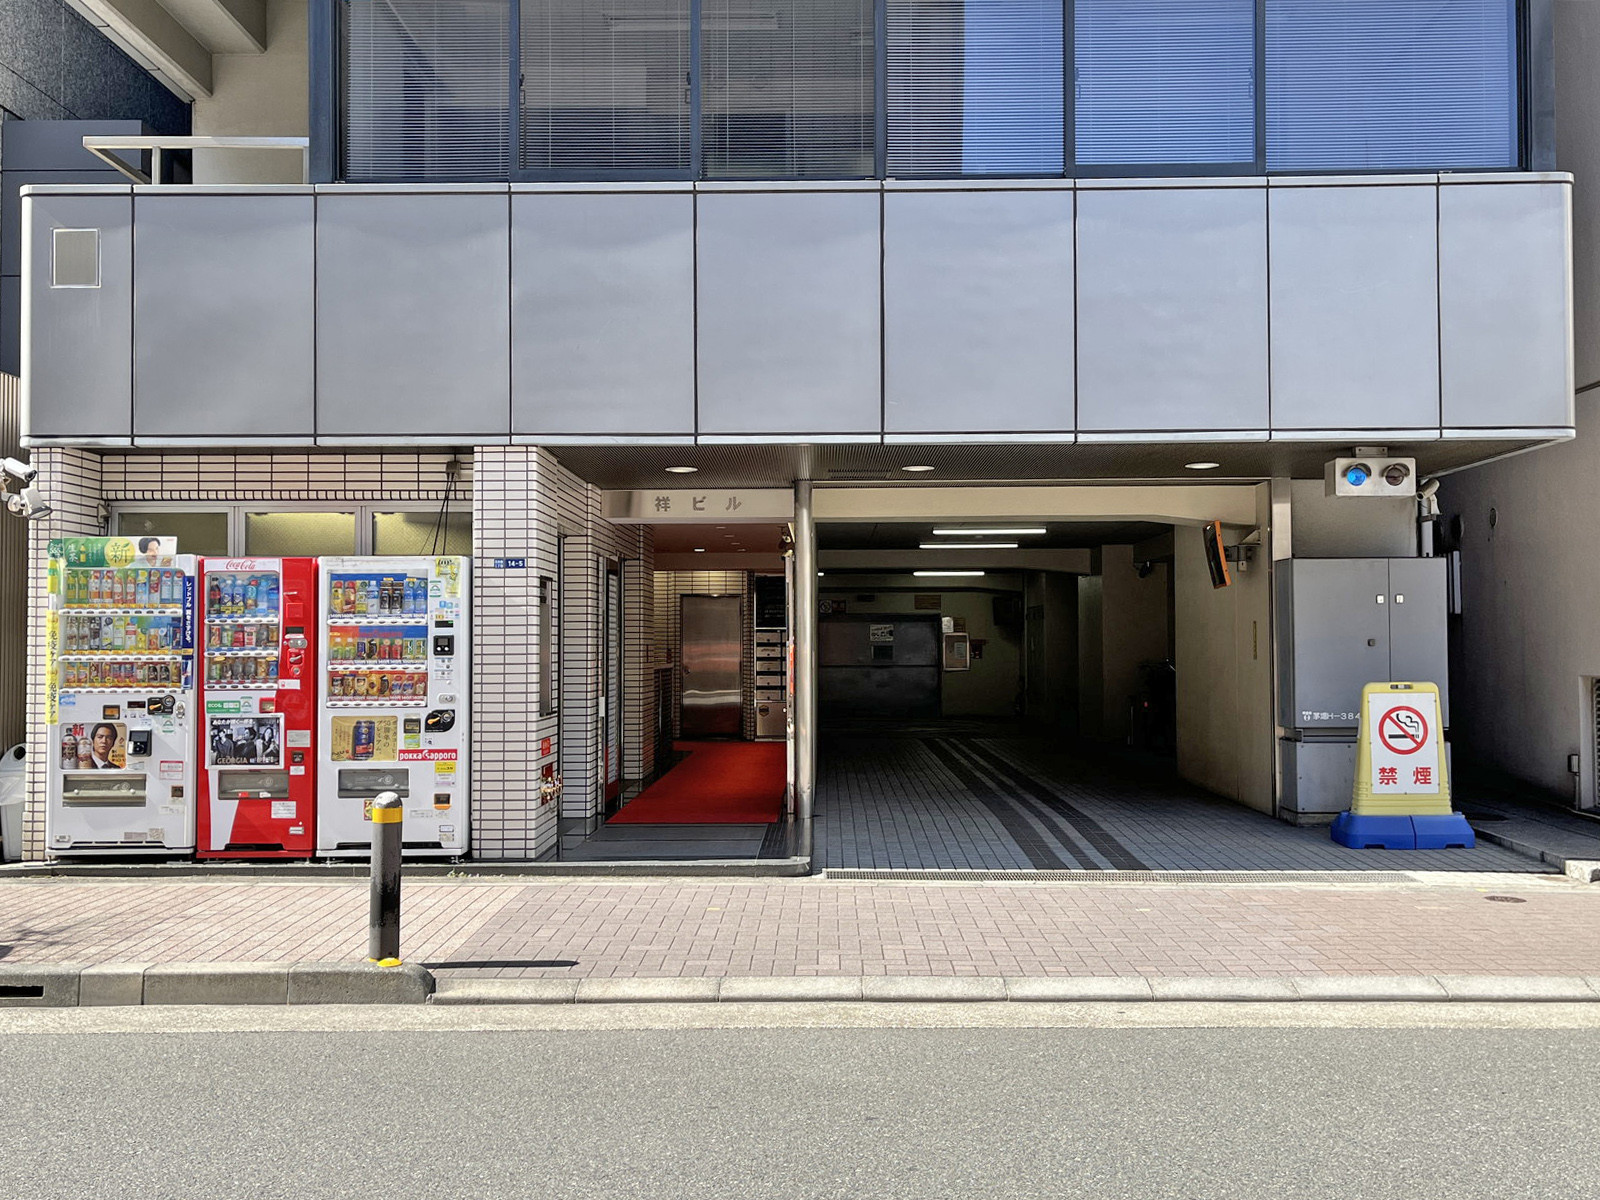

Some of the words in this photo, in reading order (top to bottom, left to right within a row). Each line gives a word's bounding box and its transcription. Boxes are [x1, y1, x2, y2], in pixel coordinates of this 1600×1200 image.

[655, 496, 742, 512] 祥ビル
[109, 542, 131, 563] 新
[72, 723, 85, 736] 新
[217, 756, 248, 764] GEORGIA
[1378, 766, 1432, 785] 禁煙
